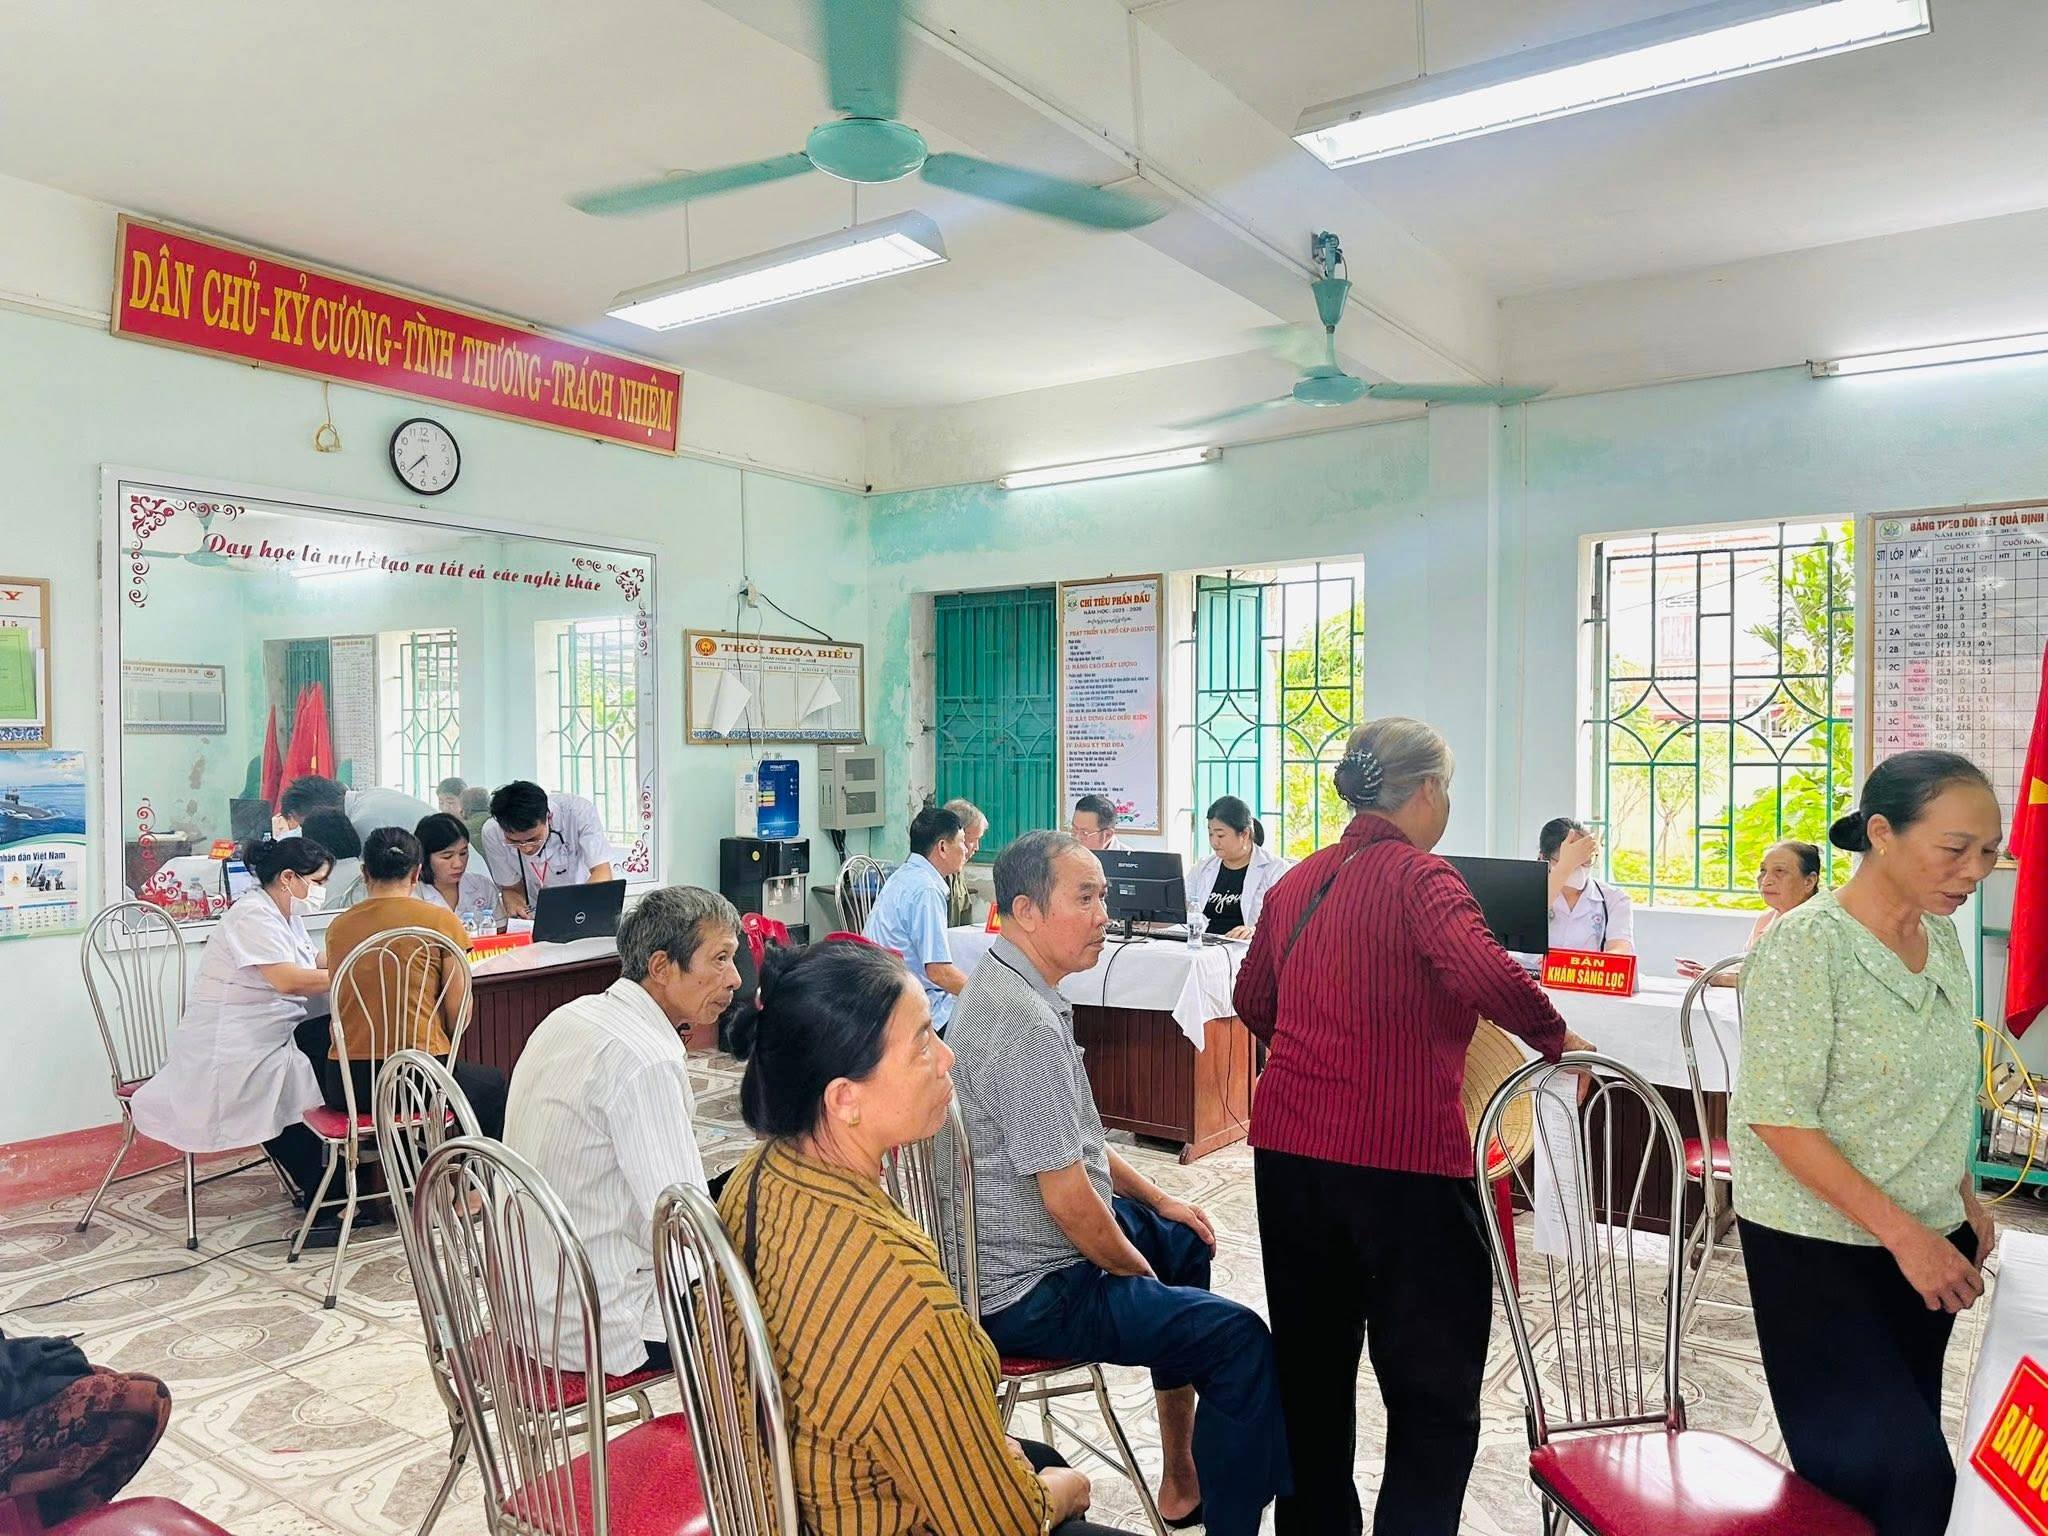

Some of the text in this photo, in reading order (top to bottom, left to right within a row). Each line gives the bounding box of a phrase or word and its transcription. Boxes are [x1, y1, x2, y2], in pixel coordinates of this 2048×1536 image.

[129, 243, 194, 319] DÂN
[617, 374, 674, 437] NHIỆM
[409, 428, 416, 437] 11
[420, 427, 429, 436] 12
[397, 448, 402, 456] 9
[440, 444, 447, 452] 2
[444, 456, 449, 465] 3
[400, 461, 405, 471] 8
[409, 472, 414, 480] 7
[432, 476, 437, 485] 5
[420, 478, 426, 487] 6
[1910, 518, 1935, 532] BẢNG
[1937, 519, 1959, 531] THEO
[1962, 516, 1978, 528] DÕI
[2000, 511, 2019, 525] QUẢ
[2021, 513, 2044, 525] ĐỊNH
[1877, 550, 1886, 561] STT
[1890, 545, 1904, 561] LỚP
[203, 533, 252, 559] Dạy
[259, 540, 295, 562] học
[301, 545, 320, 563] là
[381, 555, 409, 574] tạo
[415, 563, 434, 575] ra
[439, 560, 464, 577] tất
[493, 569, 519, 583] các
[523, 571, 560, 588] nghề
[565, 574, 601, 591] khác
[1889, 573, 1900, 581] 1A
[1080, 590, 1151, 608] CHỈ TIÊU PHẤN ĐẤU
[1889, 591, 1899, 599] 1B
[1889, 628, 1901, 636] 2A
[769, 646, 813, 657] KHÓA
[816, 646, 853, 659] BIỂU
[1888, 646, 1899, 654] 2B
[1888, 663, 1900, 671] 2C
[1888, 682, 1899, 690] 3A
[1887, 735, 1899, 743] 4A
[32, 851, 47, 861] Việt
[49, 852, 66, 860] Nam
[1209, 892, 1241, 914] onjou
[1571, 956, 1605, 967] BÀN
[1547, 964, 1625, 991] KHÁM SÀNG LỌC
